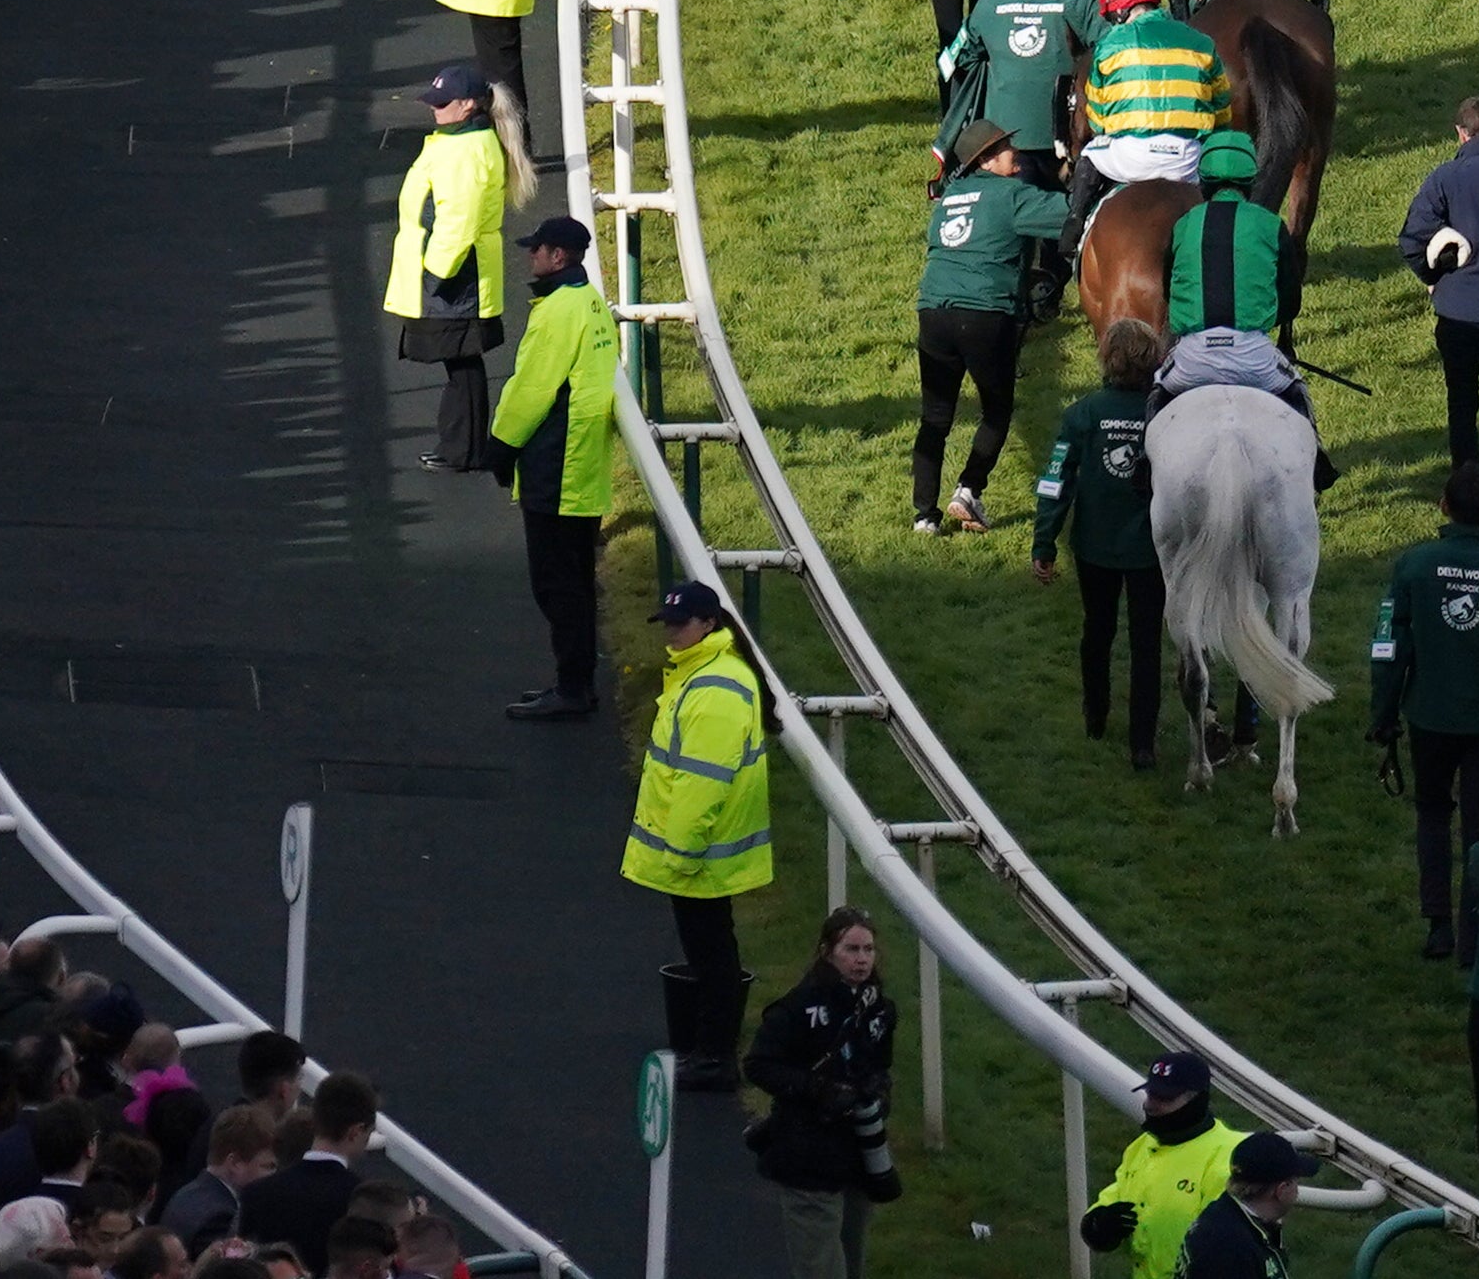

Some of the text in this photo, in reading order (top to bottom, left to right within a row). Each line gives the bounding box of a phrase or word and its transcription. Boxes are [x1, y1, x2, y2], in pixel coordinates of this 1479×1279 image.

[995, 2, 1064, 15] SCHOOL BOY HOURS
[1107, 432, 1140, 442] RANDOX
[1436, 566, 1463, 579] DELTA
[1446, 582, 1479, 594] RANDOX
[1152, 1061, 1173, 1078] G4S
